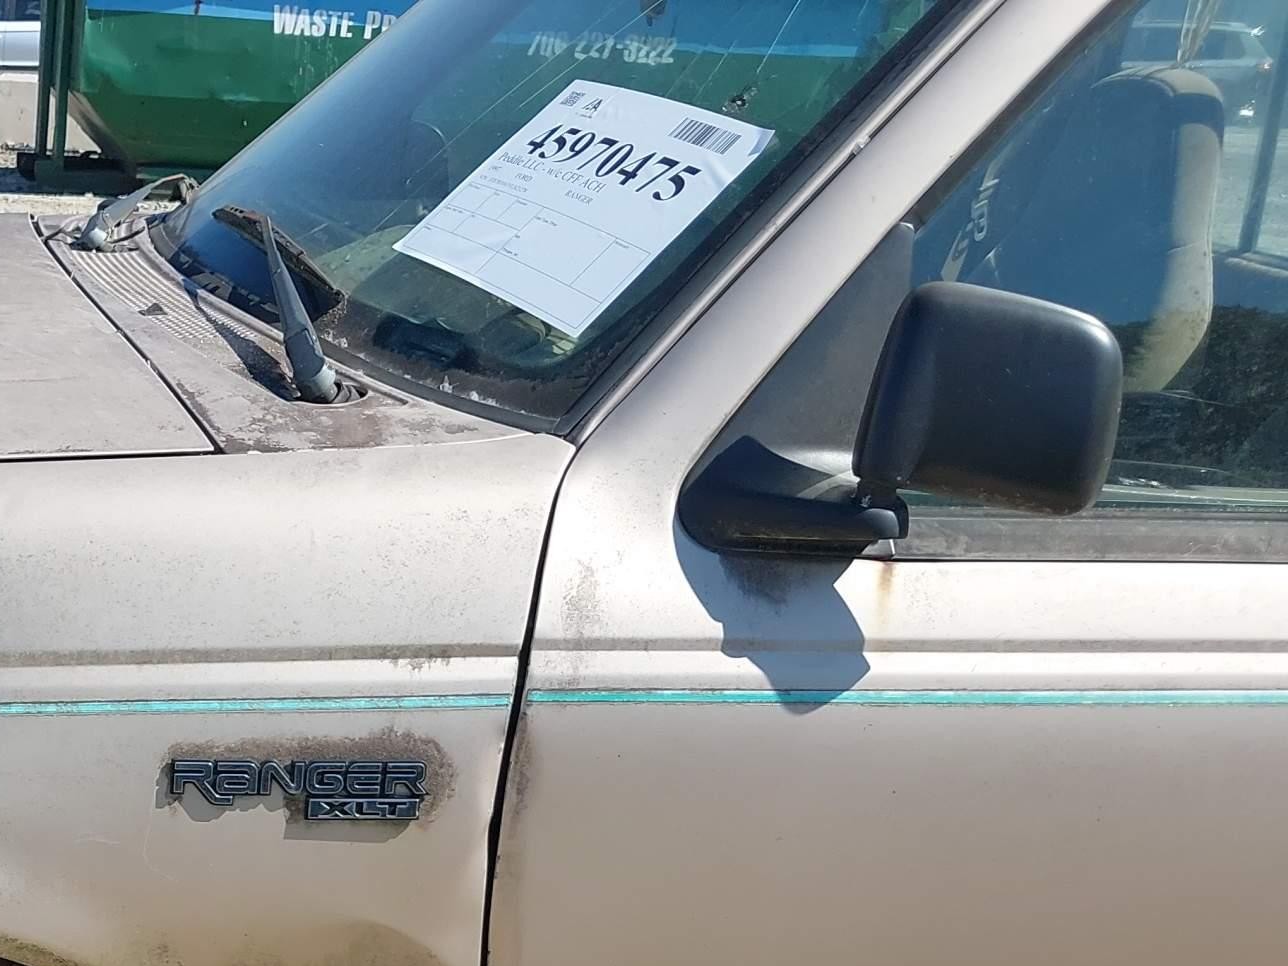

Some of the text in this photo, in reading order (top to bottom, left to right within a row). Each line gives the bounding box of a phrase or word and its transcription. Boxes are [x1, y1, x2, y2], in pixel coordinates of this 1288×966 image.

[273, 4, 355, 38] WASTE
[525, 123, 702, 202] 45970475
[171, 759, 430, 806] RANGER
[309, 798, 418, 820] XLT
